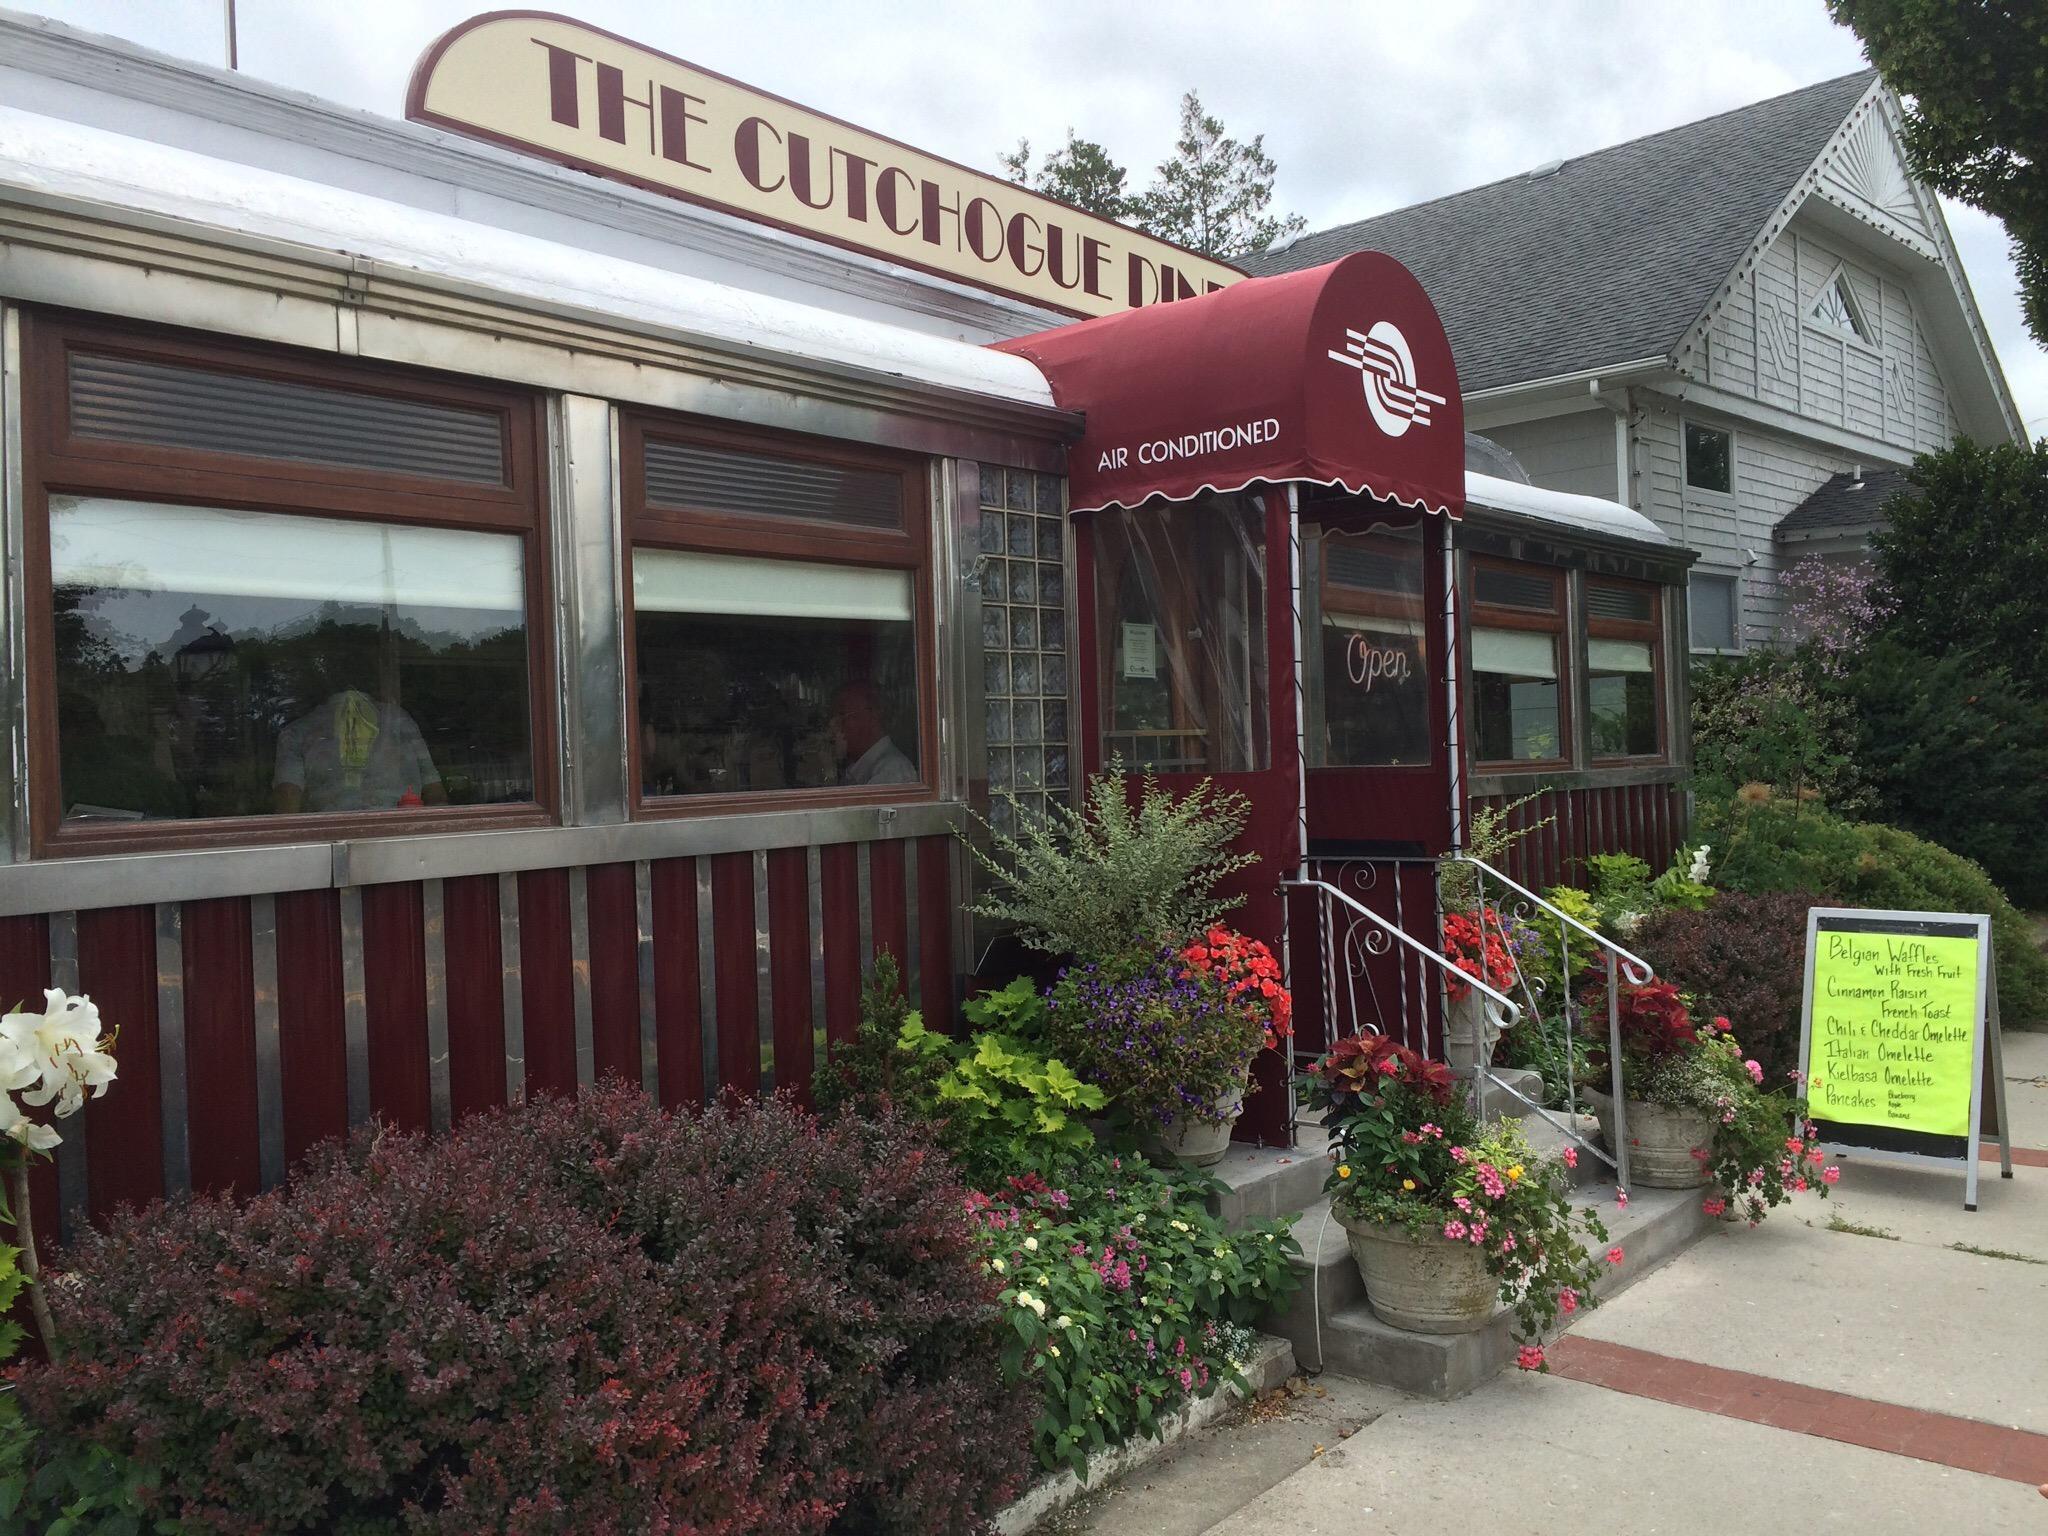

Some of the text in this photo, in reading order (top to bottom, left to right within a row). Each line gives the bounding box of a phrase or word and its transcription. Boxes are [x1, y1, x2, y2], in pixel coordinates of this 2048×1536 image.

[529, 37, 1226, 309] THE CUTCHOGUE DIN
[1097, 418, 1280, 473] AIR CONDITIONED
[1347, 633, 1411, 693] Open
[1829, 934, 1939, 967] Belgian Waffles
[1906, 963, 1933, 979] Fresh
[1937, 964, 1962, 979] Fruit
[1827, 975, 1927, 1000] Cinnamon Raisin
[1881, 999, 1952, 1019] French Toast
[1826, 1015, 1856, 1037] Chili
[1871, 1018, 1919, 1041] Cheddar
[1922, 1022, 1968, 1043] Omelette
[1824, 1039, 1934, 1062] Italian Omelette
[1827, 1060, 1934, 1087] Kielbasa Omelette
[1826, 1083, 1877, 1108] Pancakes
